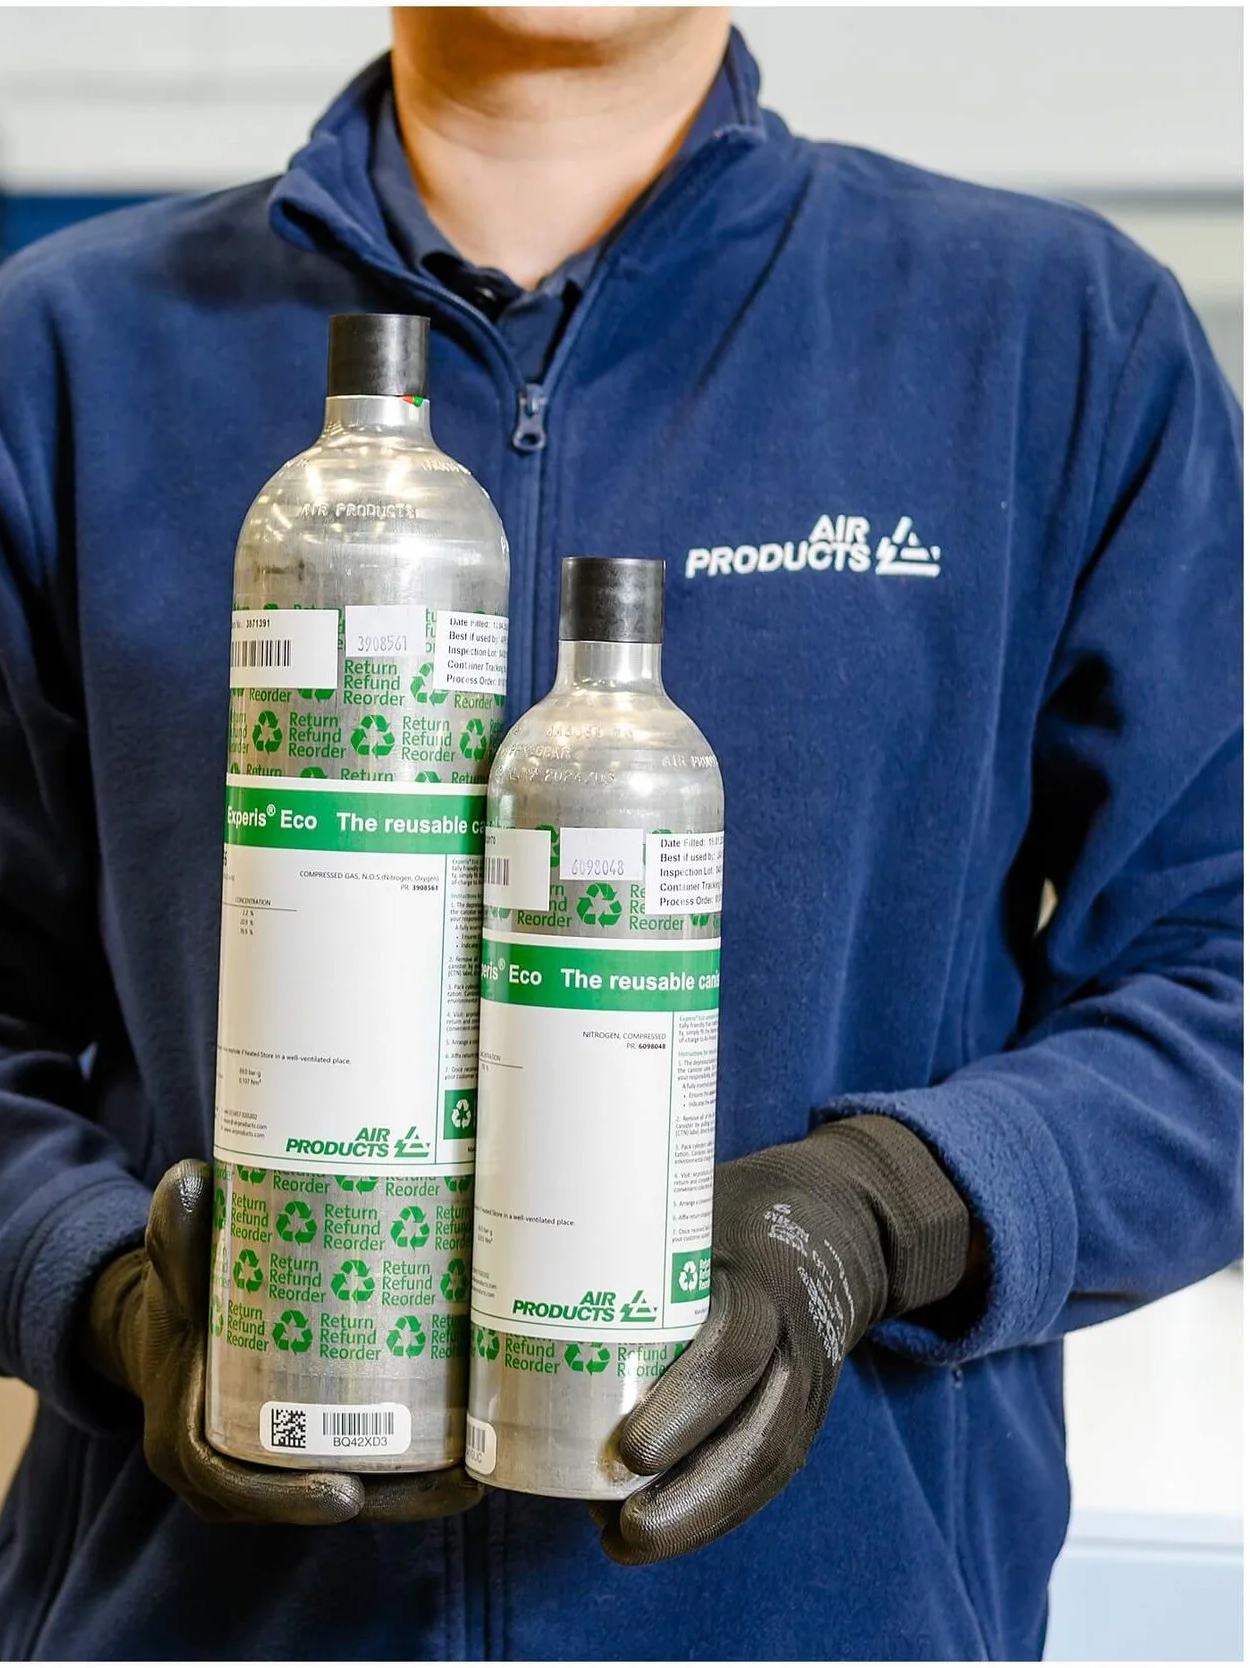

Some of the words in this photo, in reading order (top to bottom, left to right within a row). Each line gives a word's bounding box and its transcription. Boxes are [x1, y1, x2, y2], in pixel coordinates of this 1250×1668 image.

[809, 514, 870, 544] AIR
[685, 540, 871, 578] PRODUCTS
[450, 617, 468, 626] Date
[357, 635, 408, 652] 3908561
[449, 631, 467, 641] Best
[476, 634, 491, 643] used
[448, 645, 487, 658] Inspection
[345, 660, 398, 676] Return
[447, 660, 484, 672] Container
[344, 676, 401, 692] Refund
[446, 674, 478, 686] Process
[249, 688, 292, 703] Reorder
[343, 690, 406, 707] Reorder
[454, 694, 492, 709] Reorder
[290, 712, 339, 728] Return
[403, 716, 450, 732] Return
[289, 727, 342, 744] Refund
[288, 743, 347, 759] Reorder
[402, 747, 456, 762] Reorder
[247, 764, 282, 777] Return
[340, 768, 394, 782] Return
[280, 809, 318, 830] Eco
[337, 812, 378, 833] The
[384, 815, 468, 835] reusable
[660, 839, 681, 848] Date
[660, 852, 681, 863] Best
[683, 853, 689, 862] if
[690, 852, 707, 862] used
[299, 870, 344, 880] COMPRESSED
[344, 872, 360, 881] GAS,
[571, 859, 625, 876] 6098048
[660, 867, 703, 878] Inspection
[659, 882, 700, 892] Container
[659, 896, 694, 907] Process
[517, 911, 573, 928] Reorder
[628, 917, 685, 932] Reorder
[509, 964, 543, 985] Eco
[561, 968, 602, 990] The
[610, 971, 696, 991] reusable
[622, 1032, 667, 1040] COMPRESSED
[638, 1043, 666, 1051] 6098048
[287, 1054, 332, 1064] well-ventilated
[355, 1127, 390, 1143] AIR
[285, 1138, 390, 1158] PRODUCTS
[273, 1174, 330, 1195] Reorder
[385, 1182, 440, 1197] Reorder
[231, 1192, 267, 1213] Return
[231, 1208, 269, 1228] Refund
[324, 1204, 378, 1220] Return
[230, 1223, 273, 1244] Reorder
[324, 1219, 381, 1236] Refund
[323, 1235, 386, 1251] Reorder
[270, 1252, 319, 1272] Return
[382, 1260, 430, 1276] Return
[269, 1269, 322, 1288] Refund
[382, 1275, 433, 1291] Refund
[268, 1284, 327, 1303] Reorder
[381, 1291, 437, 1306] Reorder
[579, 1290, 615, 1307] AIR
[228, 1299, 264, 1321] Return
[512, 1299, 616, 1323] PRODUCTS
[227, 1315, 266, 1337] Refund
[320, 1312, 374, 1330] Return
[226, 1330, 269, 1352] Reorder
[319, 1328, 378, 1346] Refund
[319, 1343, 383, 1361] Reorder
[505, 1336, 556, 1358] Refund
[504, 1352, 561, 1375] Reorder
[616, 1361, 667, 1377] Rorde
[332, 1435, 388, 1448] BQ42XD3
